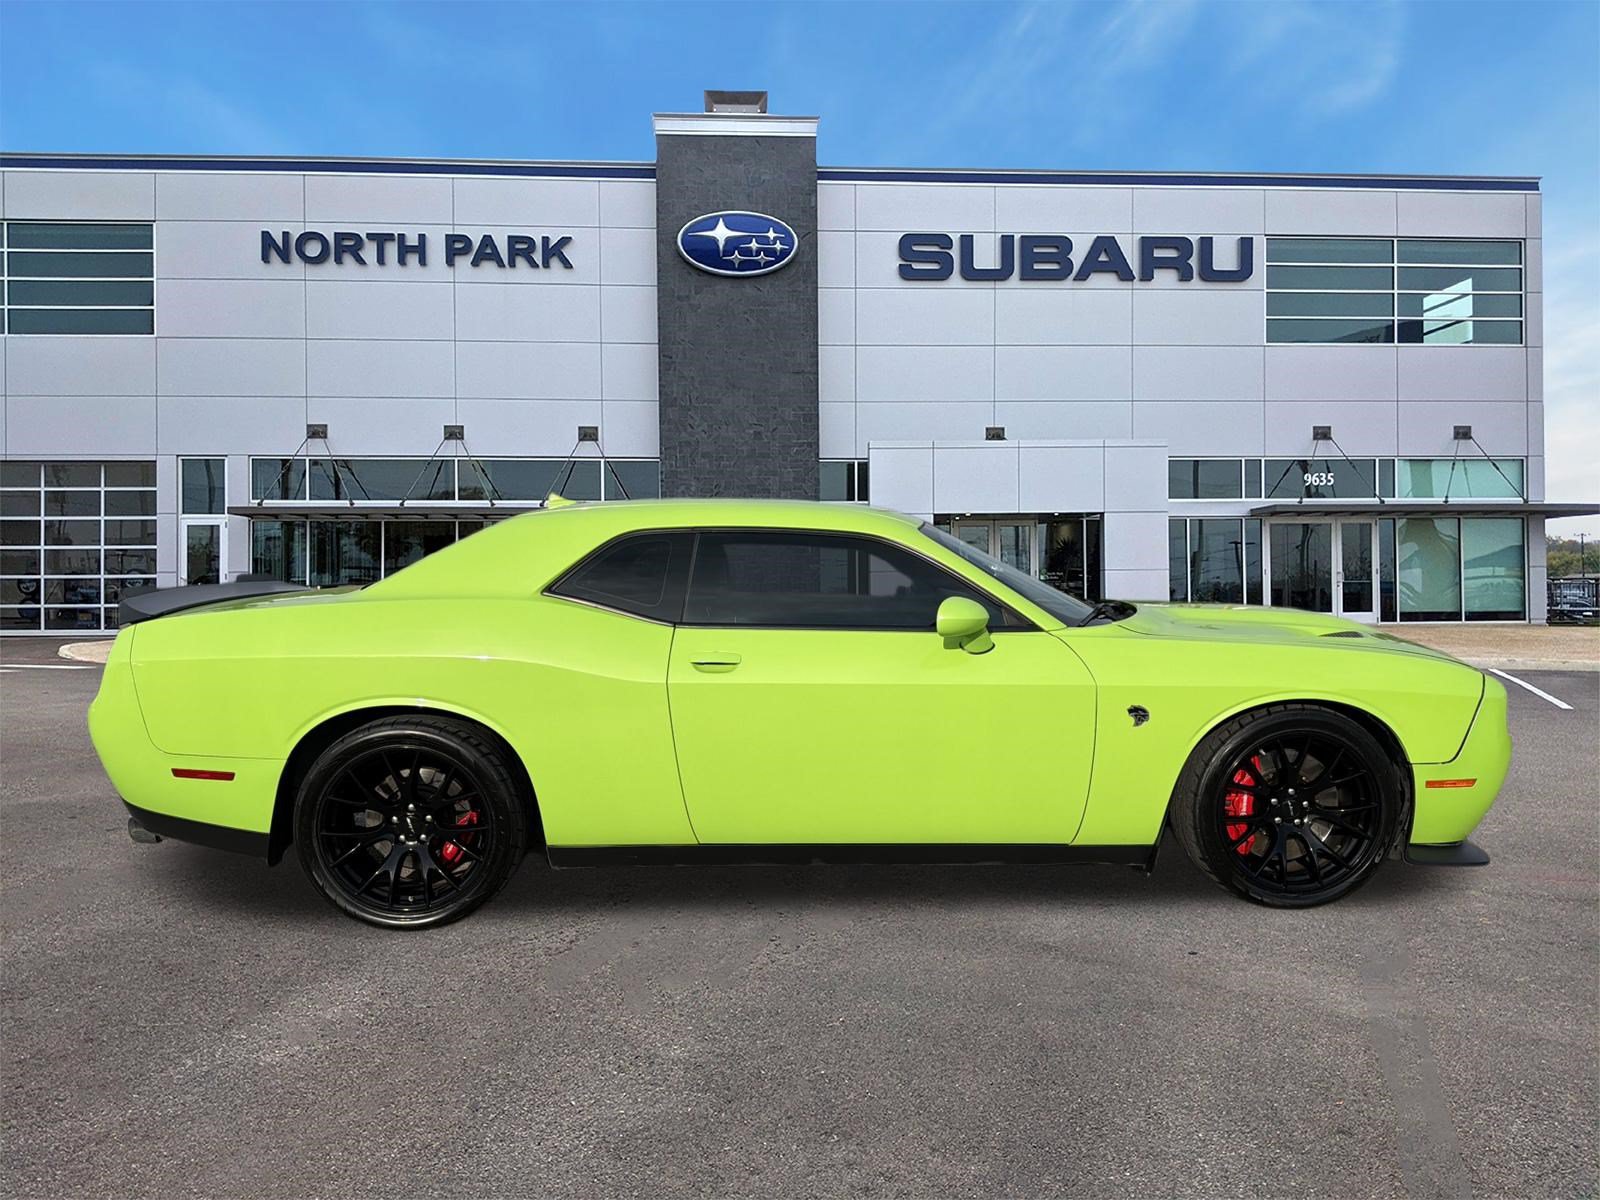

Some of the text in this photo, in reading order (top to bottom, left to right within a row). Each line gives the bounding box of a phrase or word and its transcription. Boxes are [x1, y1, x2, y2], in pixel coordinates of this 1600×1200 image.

[260, 230, 574, 269] NORTH PARK
[898, 232, 1254, 282] SUBARU
[1303, 472, 1335, 486] 9635
